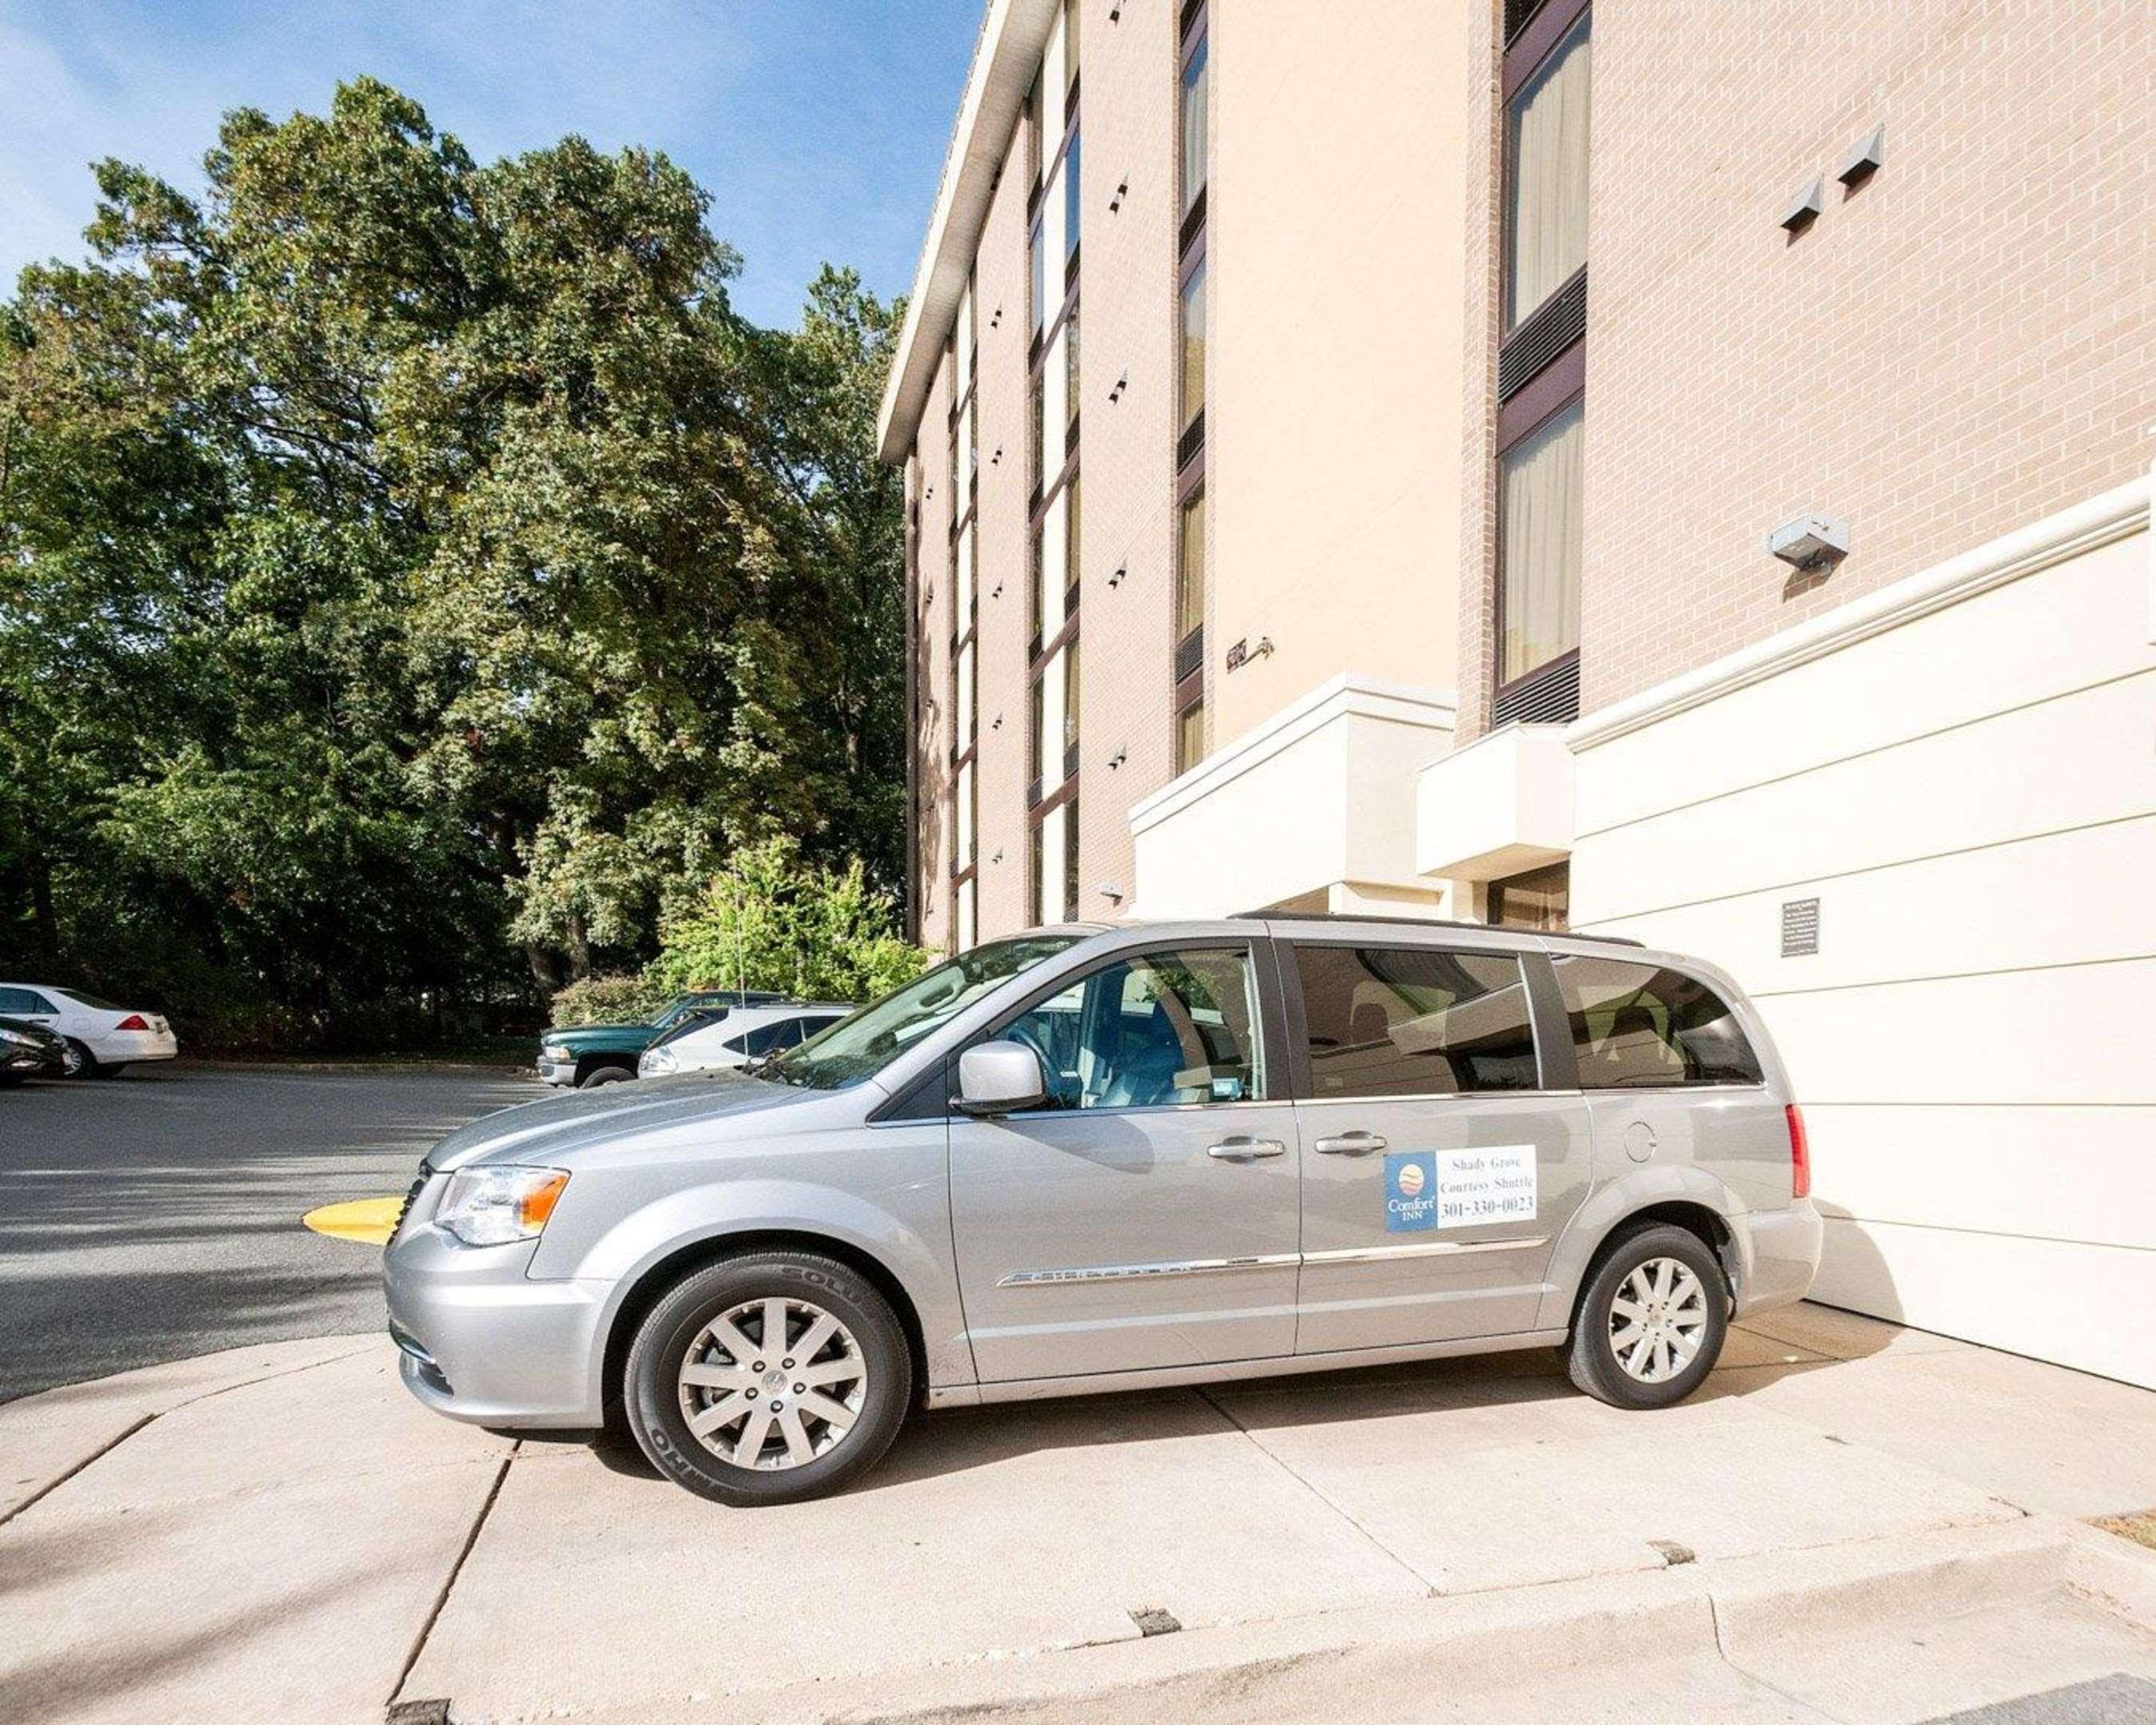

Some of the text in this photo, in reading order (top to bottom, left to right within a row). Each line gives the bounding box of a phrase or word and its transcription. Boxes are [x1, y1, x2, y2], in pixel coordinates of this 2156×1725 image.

[1452, 1157, 1521, 1172] Shady Grove
[1440, 1175, 1533, 1194] Courtesy Shuttle
[1388, 1196, 1433, 1212] Comfort
[1441, 1196, 1533, 1218] 301-330-0023
[1402, 1210, 1423, 1221] INN
